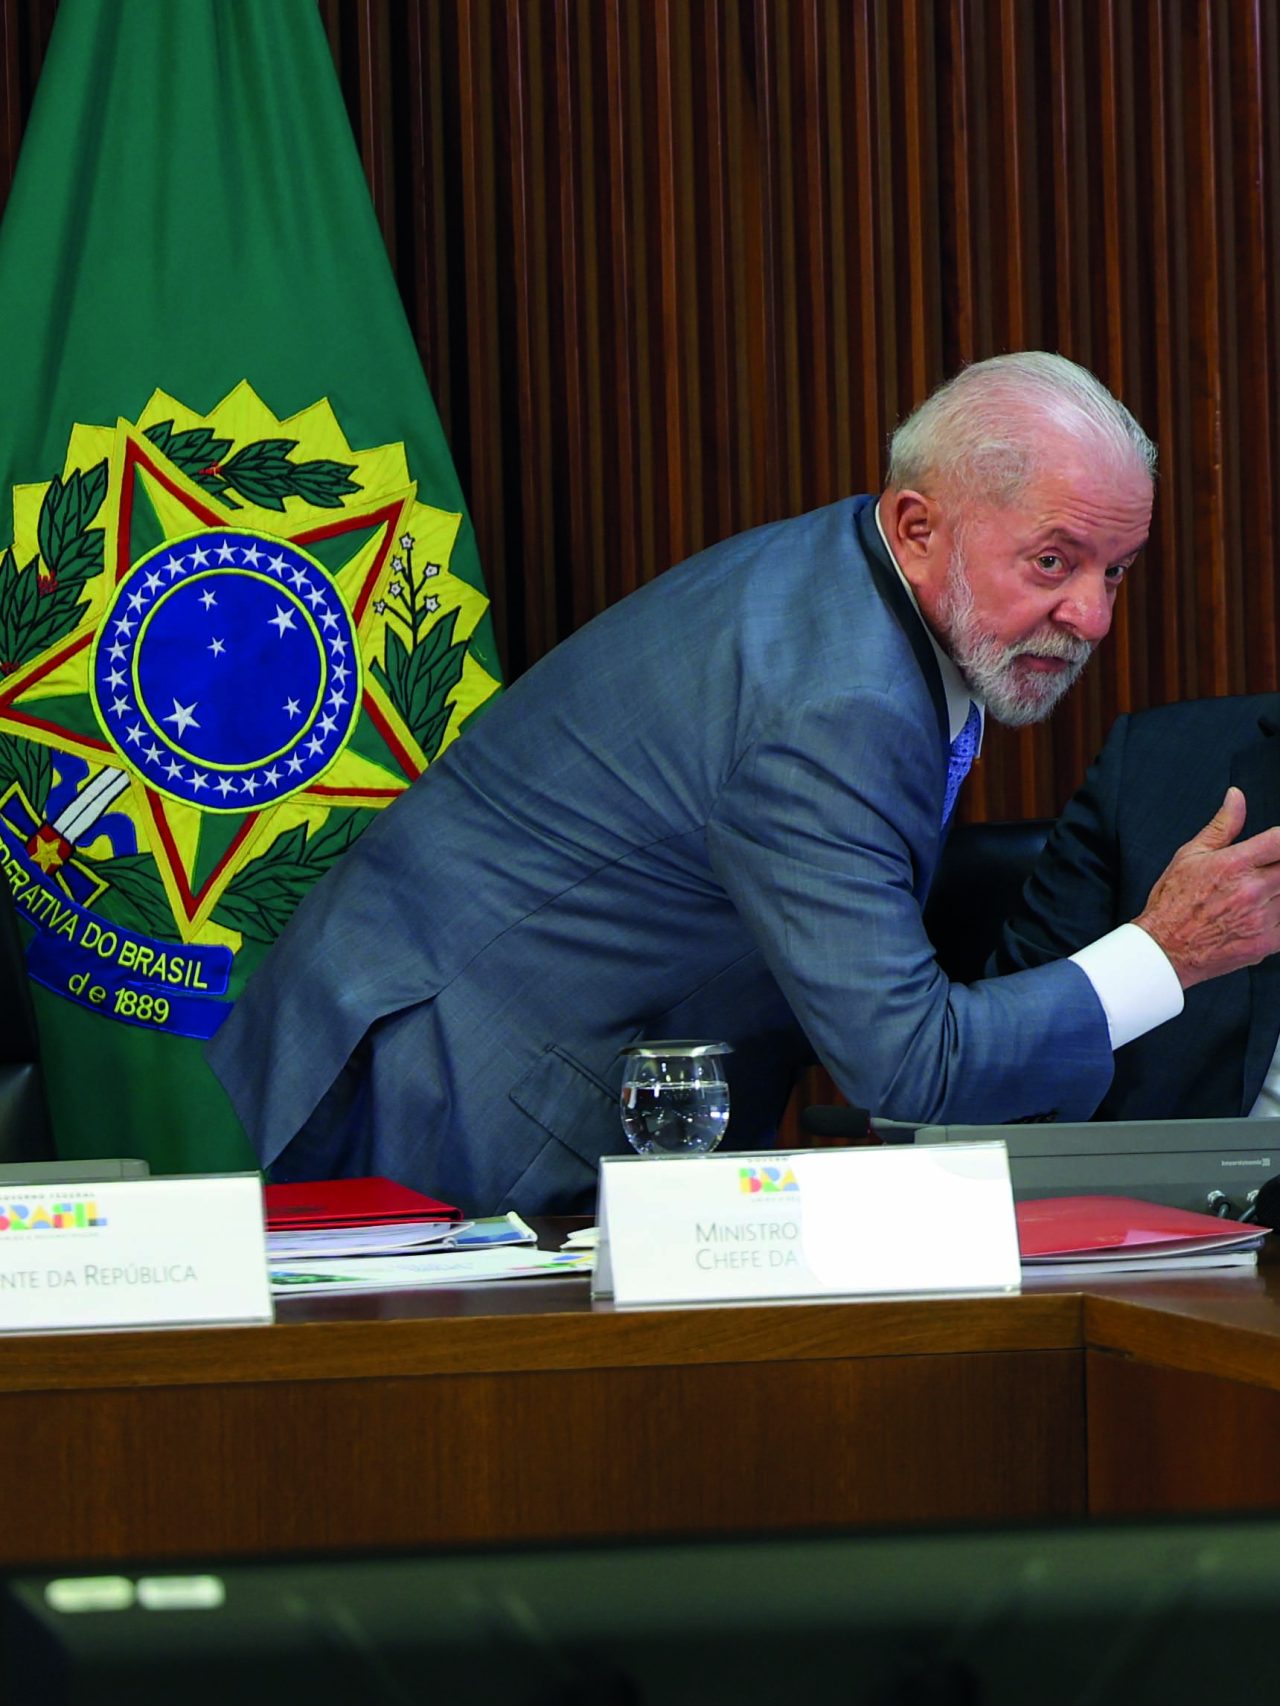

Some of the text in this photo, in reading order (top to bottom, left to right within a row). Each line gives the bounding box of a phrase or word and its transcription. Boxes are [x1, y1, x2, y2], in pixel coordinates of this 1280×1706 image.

[79, 921, 118, 958] DO
[117, 940, 208, 989] BRASIL
[68, 972, 170, 1024] de 1889
[694, 1221, 799, 1243] MINISTRO
[695, 1248, 798, 1270] CHEFE DA
[47, 1269, 78, 1288] DA
[83, 1262, 199, 1286] REPÚBLICA
